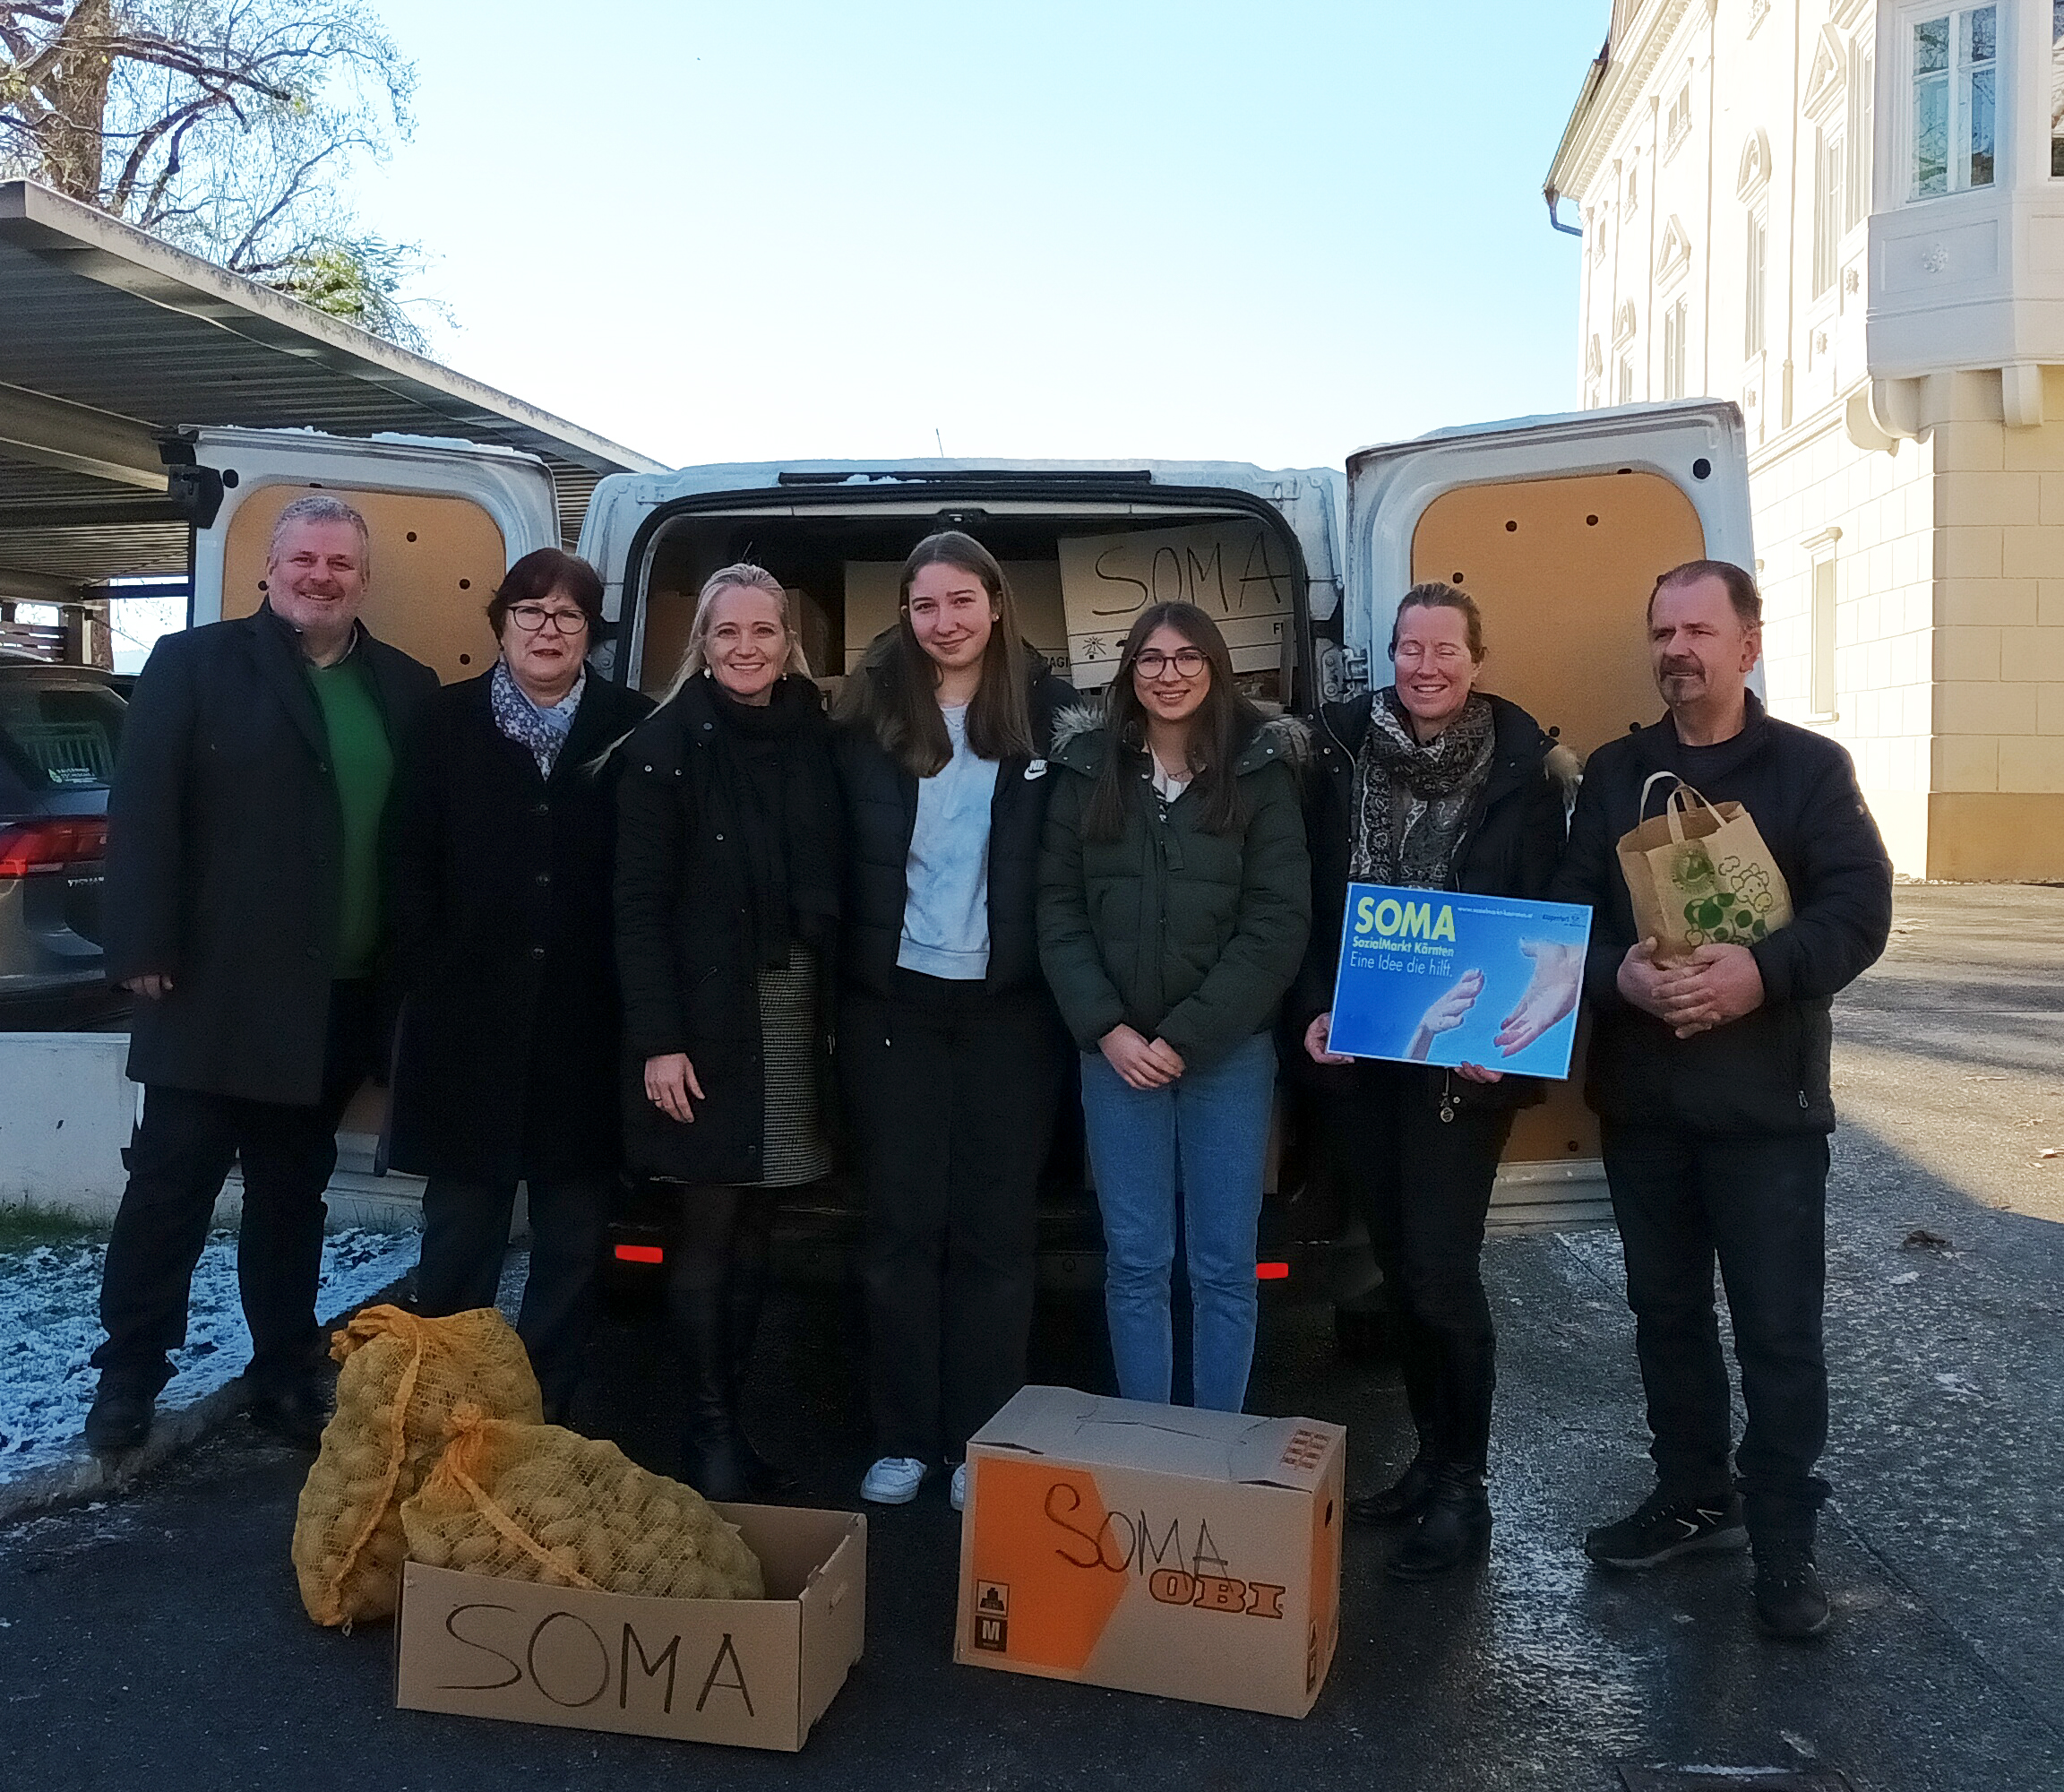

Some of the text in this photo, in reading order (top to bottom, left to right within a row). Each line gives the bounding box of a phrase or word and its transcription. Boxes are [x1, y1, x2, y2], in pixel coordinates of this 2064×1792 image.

[1092, 531, 1292, 616] SOMA
[1354, 896, 1456, 942] SOMA
[1350, 951, 1452, 978] Eine Idee die hilft.
[1353, 935, 1454, 957] SozialMarkt Kärnten
[1045, 1483, 1234, 1593] SOMA
[1149, 1568, 1286, 1619] OBI
[982, 1619, 1001, 1641] M
[434, 1603, 755, 1718] SOMA
